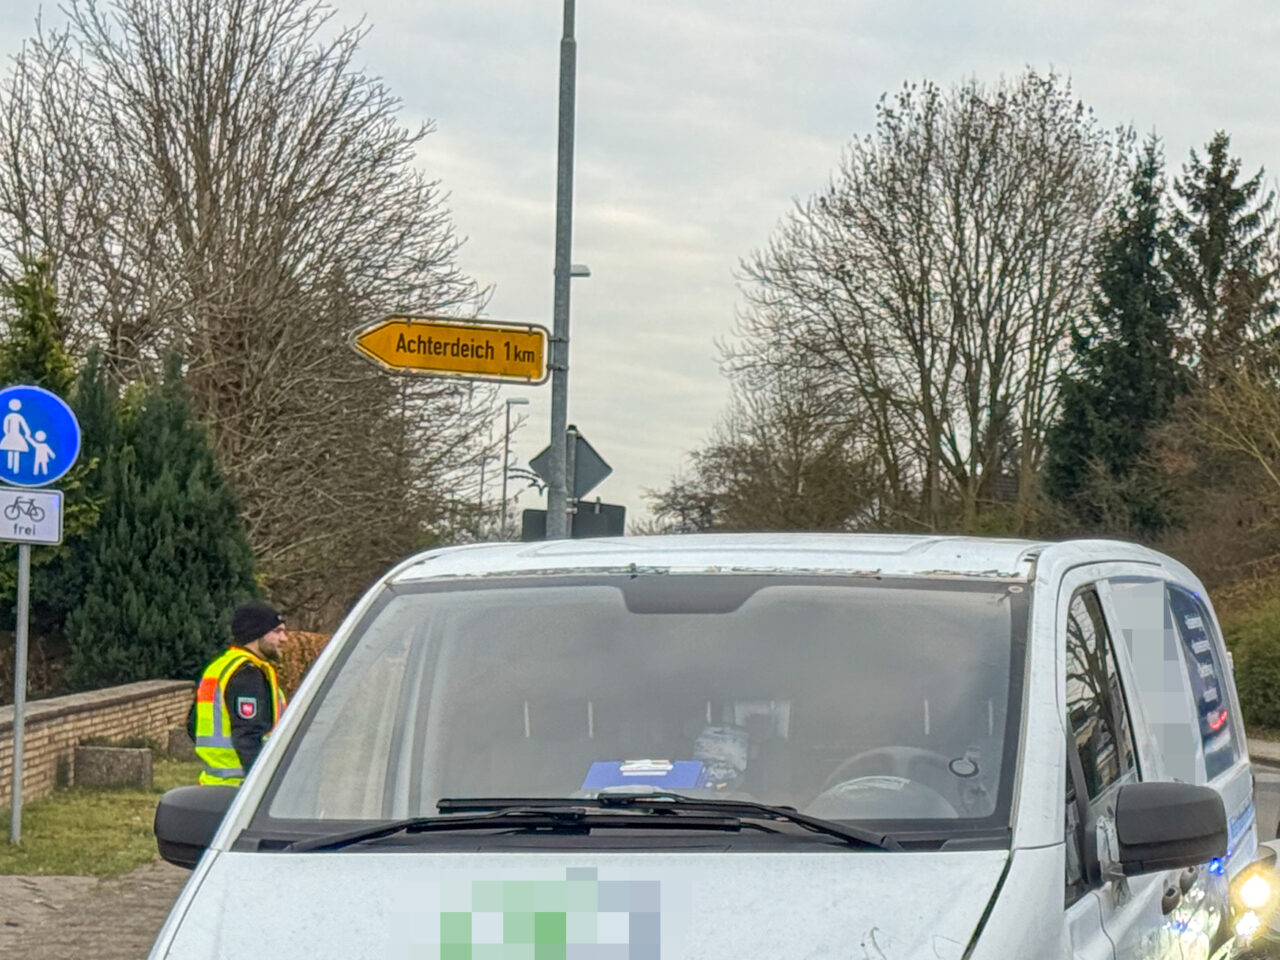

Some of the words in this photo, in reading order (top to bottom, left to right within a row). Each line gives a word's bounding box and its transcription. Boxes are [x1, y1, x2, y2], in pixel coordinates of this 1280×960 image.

[396, 332, 494, 361] Achterdeich
[504, 341, 511, 361] 1
[514, 346, 535, 363] km
[13, 523, 36, 535] frei
